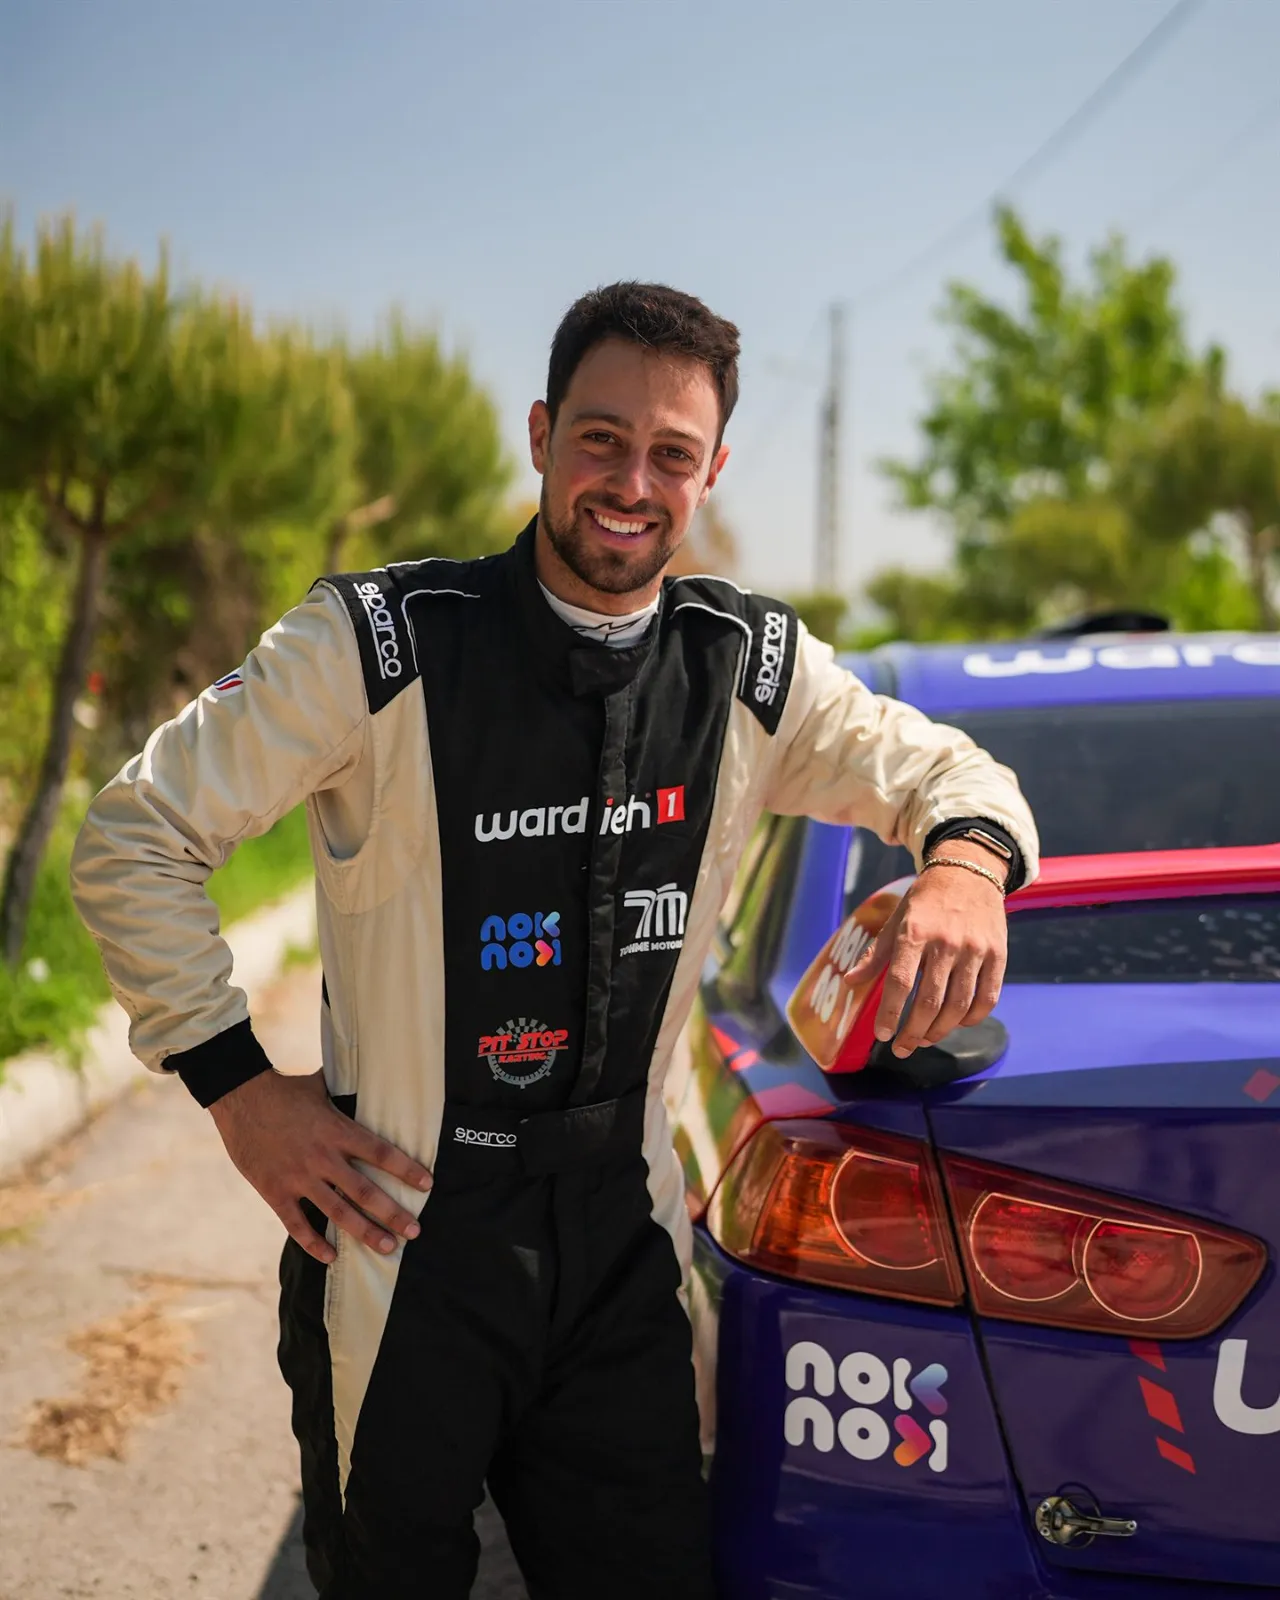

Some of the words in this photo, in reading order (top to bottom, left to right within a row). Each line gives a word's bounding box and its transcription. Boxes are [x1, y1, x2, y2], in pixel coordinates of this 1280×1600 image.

[354, 582, 402, 680] sparco
[755, 612, 788, 706] sparco
[667, 791, 677, 818] 1
[478, 1035, 513, 1054] PIT
[516, 1030, 569, 1051] STOP
[453, 1126, 518, 1148] sparco
